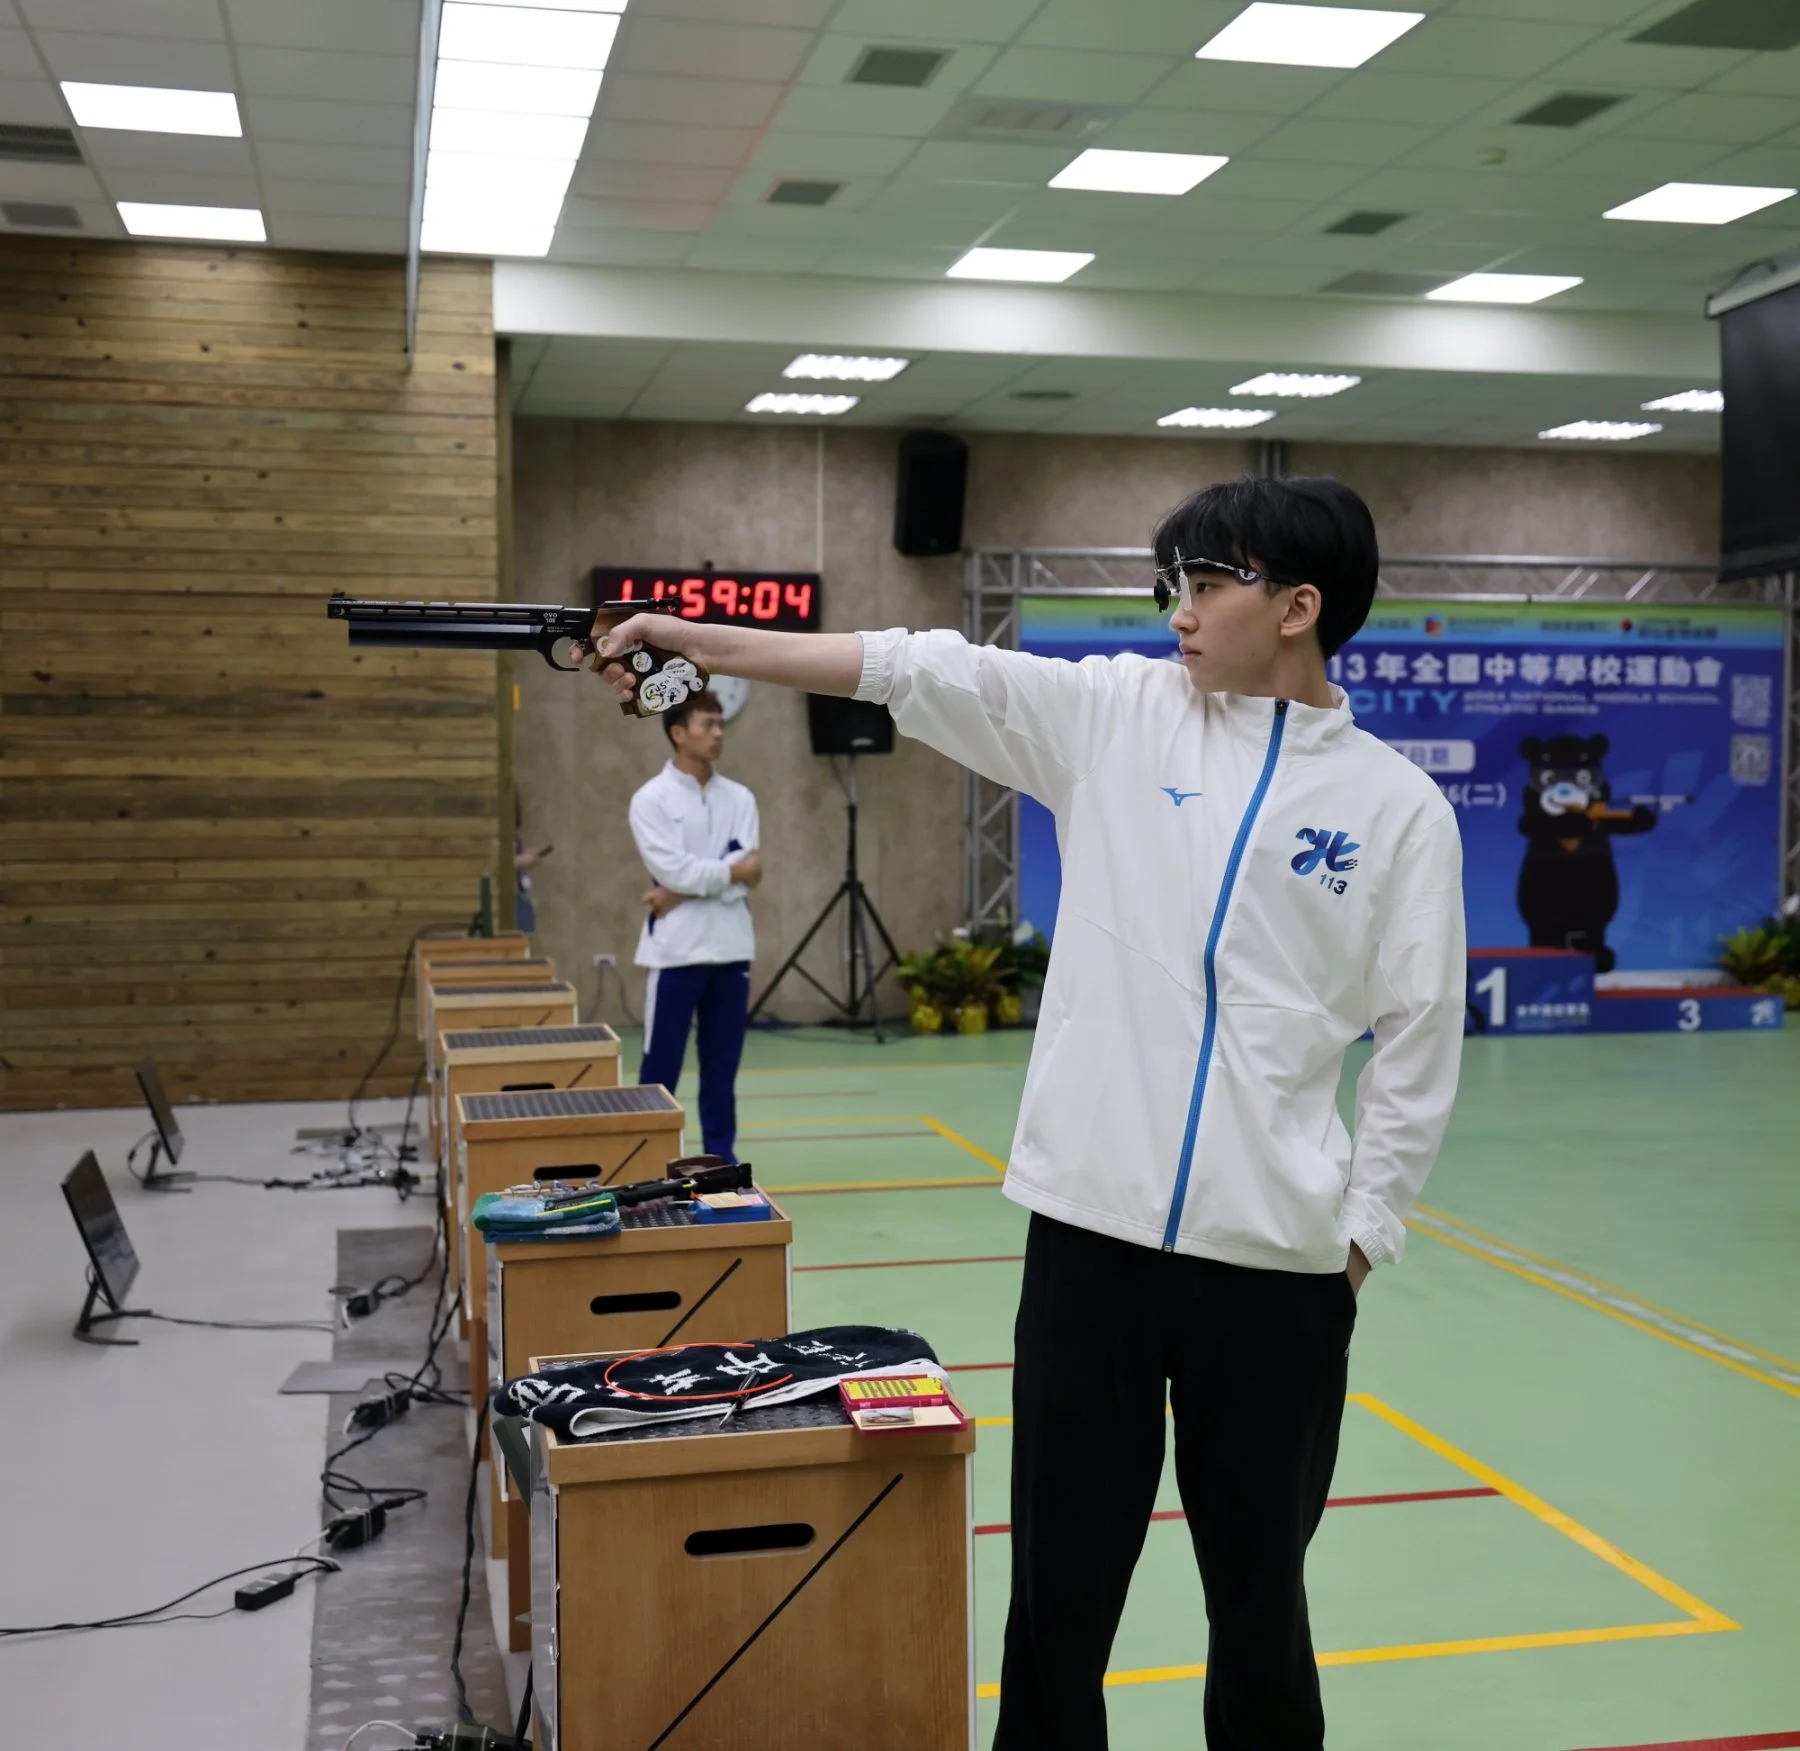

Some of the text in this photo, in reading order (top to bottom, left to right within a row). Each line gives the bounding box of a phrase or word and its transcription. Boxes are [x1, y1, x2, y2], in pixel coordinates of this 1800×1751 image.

[621, 578, 812, 619] 11:59:04
[1348, 688, 1458, 714] CITY
[1319, 873, 1349, 896] 113
[1475, 966, 1508, 1027] 1
[1677, 998, 1702, 1032] 3
